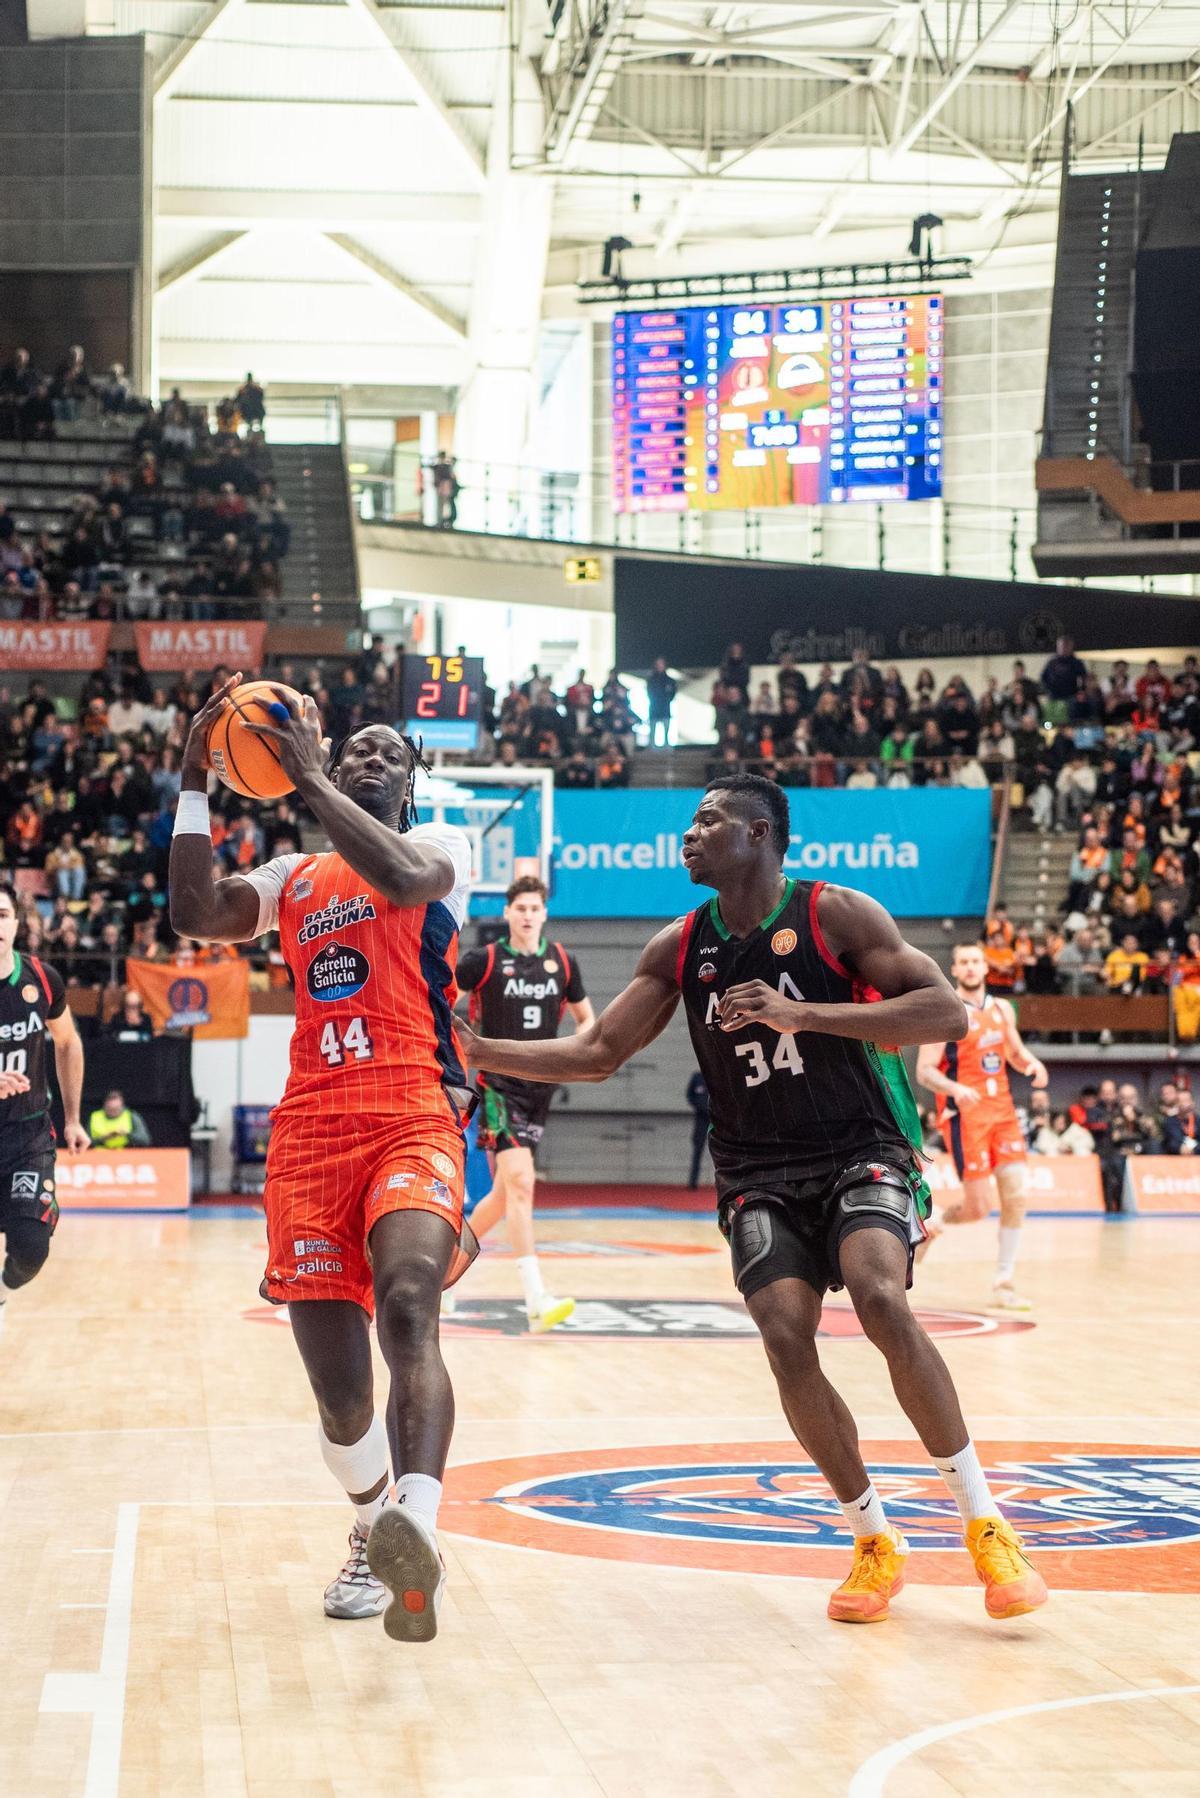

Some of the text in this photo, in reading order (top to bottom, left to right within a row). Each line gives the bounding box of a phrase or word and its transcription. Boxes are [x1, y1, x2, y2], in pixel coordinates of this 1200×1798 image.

[0, 628, 95, 652] MASTIL
[151, 629, 250, 652] MASTIL
[416, 682, 471, 718] 21
[551, 833, 919, 869] oncell Coruña
[304, 894, 369, 926] BASQUET
[313, 956, 356, 975] Estrella
[314, 969, 356, 988] Galicia
[0, 1011, 43, 1041] egA
[523, 1005, 541, 1029] 9
[320, 1017, 373, 1068] 44
[735, 1032, 805, 1087] 34
